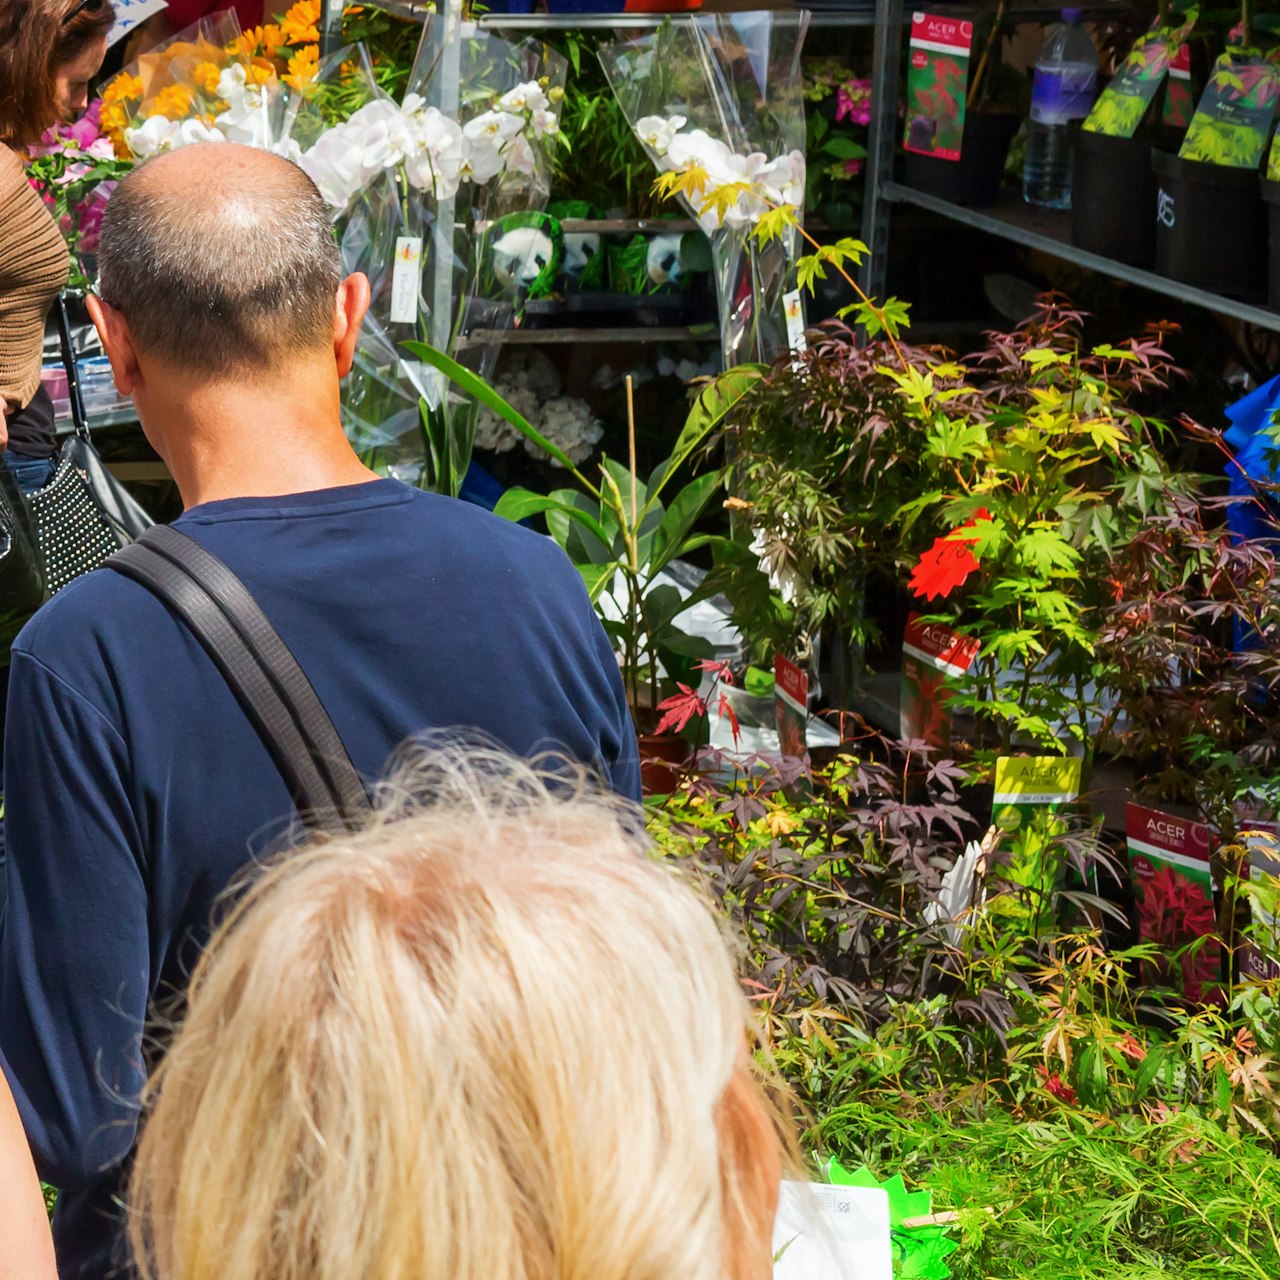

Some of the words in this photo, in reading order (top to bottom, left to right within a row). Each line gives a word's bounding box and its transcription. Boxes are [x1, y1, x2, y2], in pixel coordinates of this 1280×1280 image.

[928, 21, 956, 35] ACER
[1020, 766, 1059, 778] ACER
[1147, 818, 1186, 840] ACER
